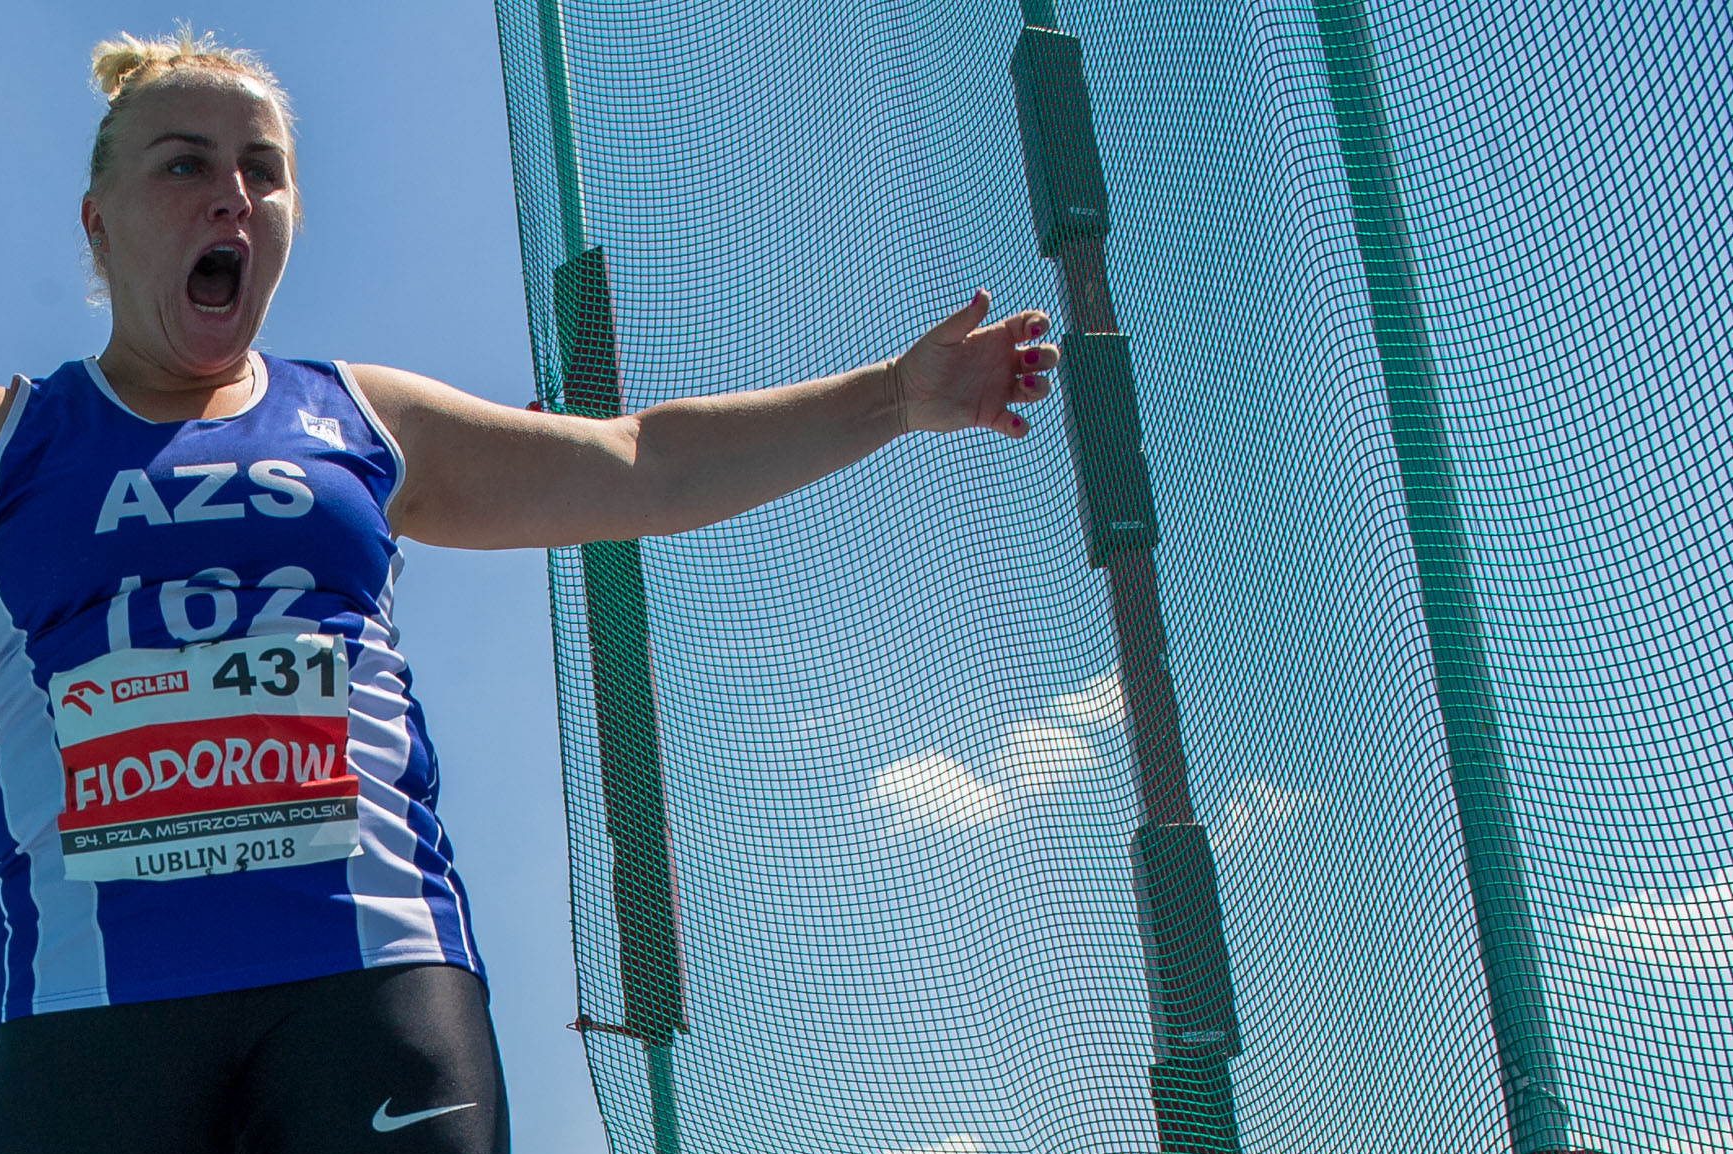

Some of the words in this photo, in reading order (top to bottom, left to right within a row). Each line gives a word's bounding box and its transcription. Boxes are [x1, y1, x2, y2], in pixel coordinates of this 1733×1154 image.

[94, 459, 315, 535] AZS
[107, 566, 321, 653] 162
[116, 673, 185, 699] ORLEN
[212, 647, 336, 698] 431
[74, 737, 336, 812] FIODOROW
[74, 834, 104, 849] 94.
[106, 829, 152, 844] PZLA
[156, 811, 286, 838] MISTRZOSTWA
[290, 803, 347, 822] POLSKI
[135, 845, 227, 877] LUBLIN
[235, 837, 296, 864] 2018
